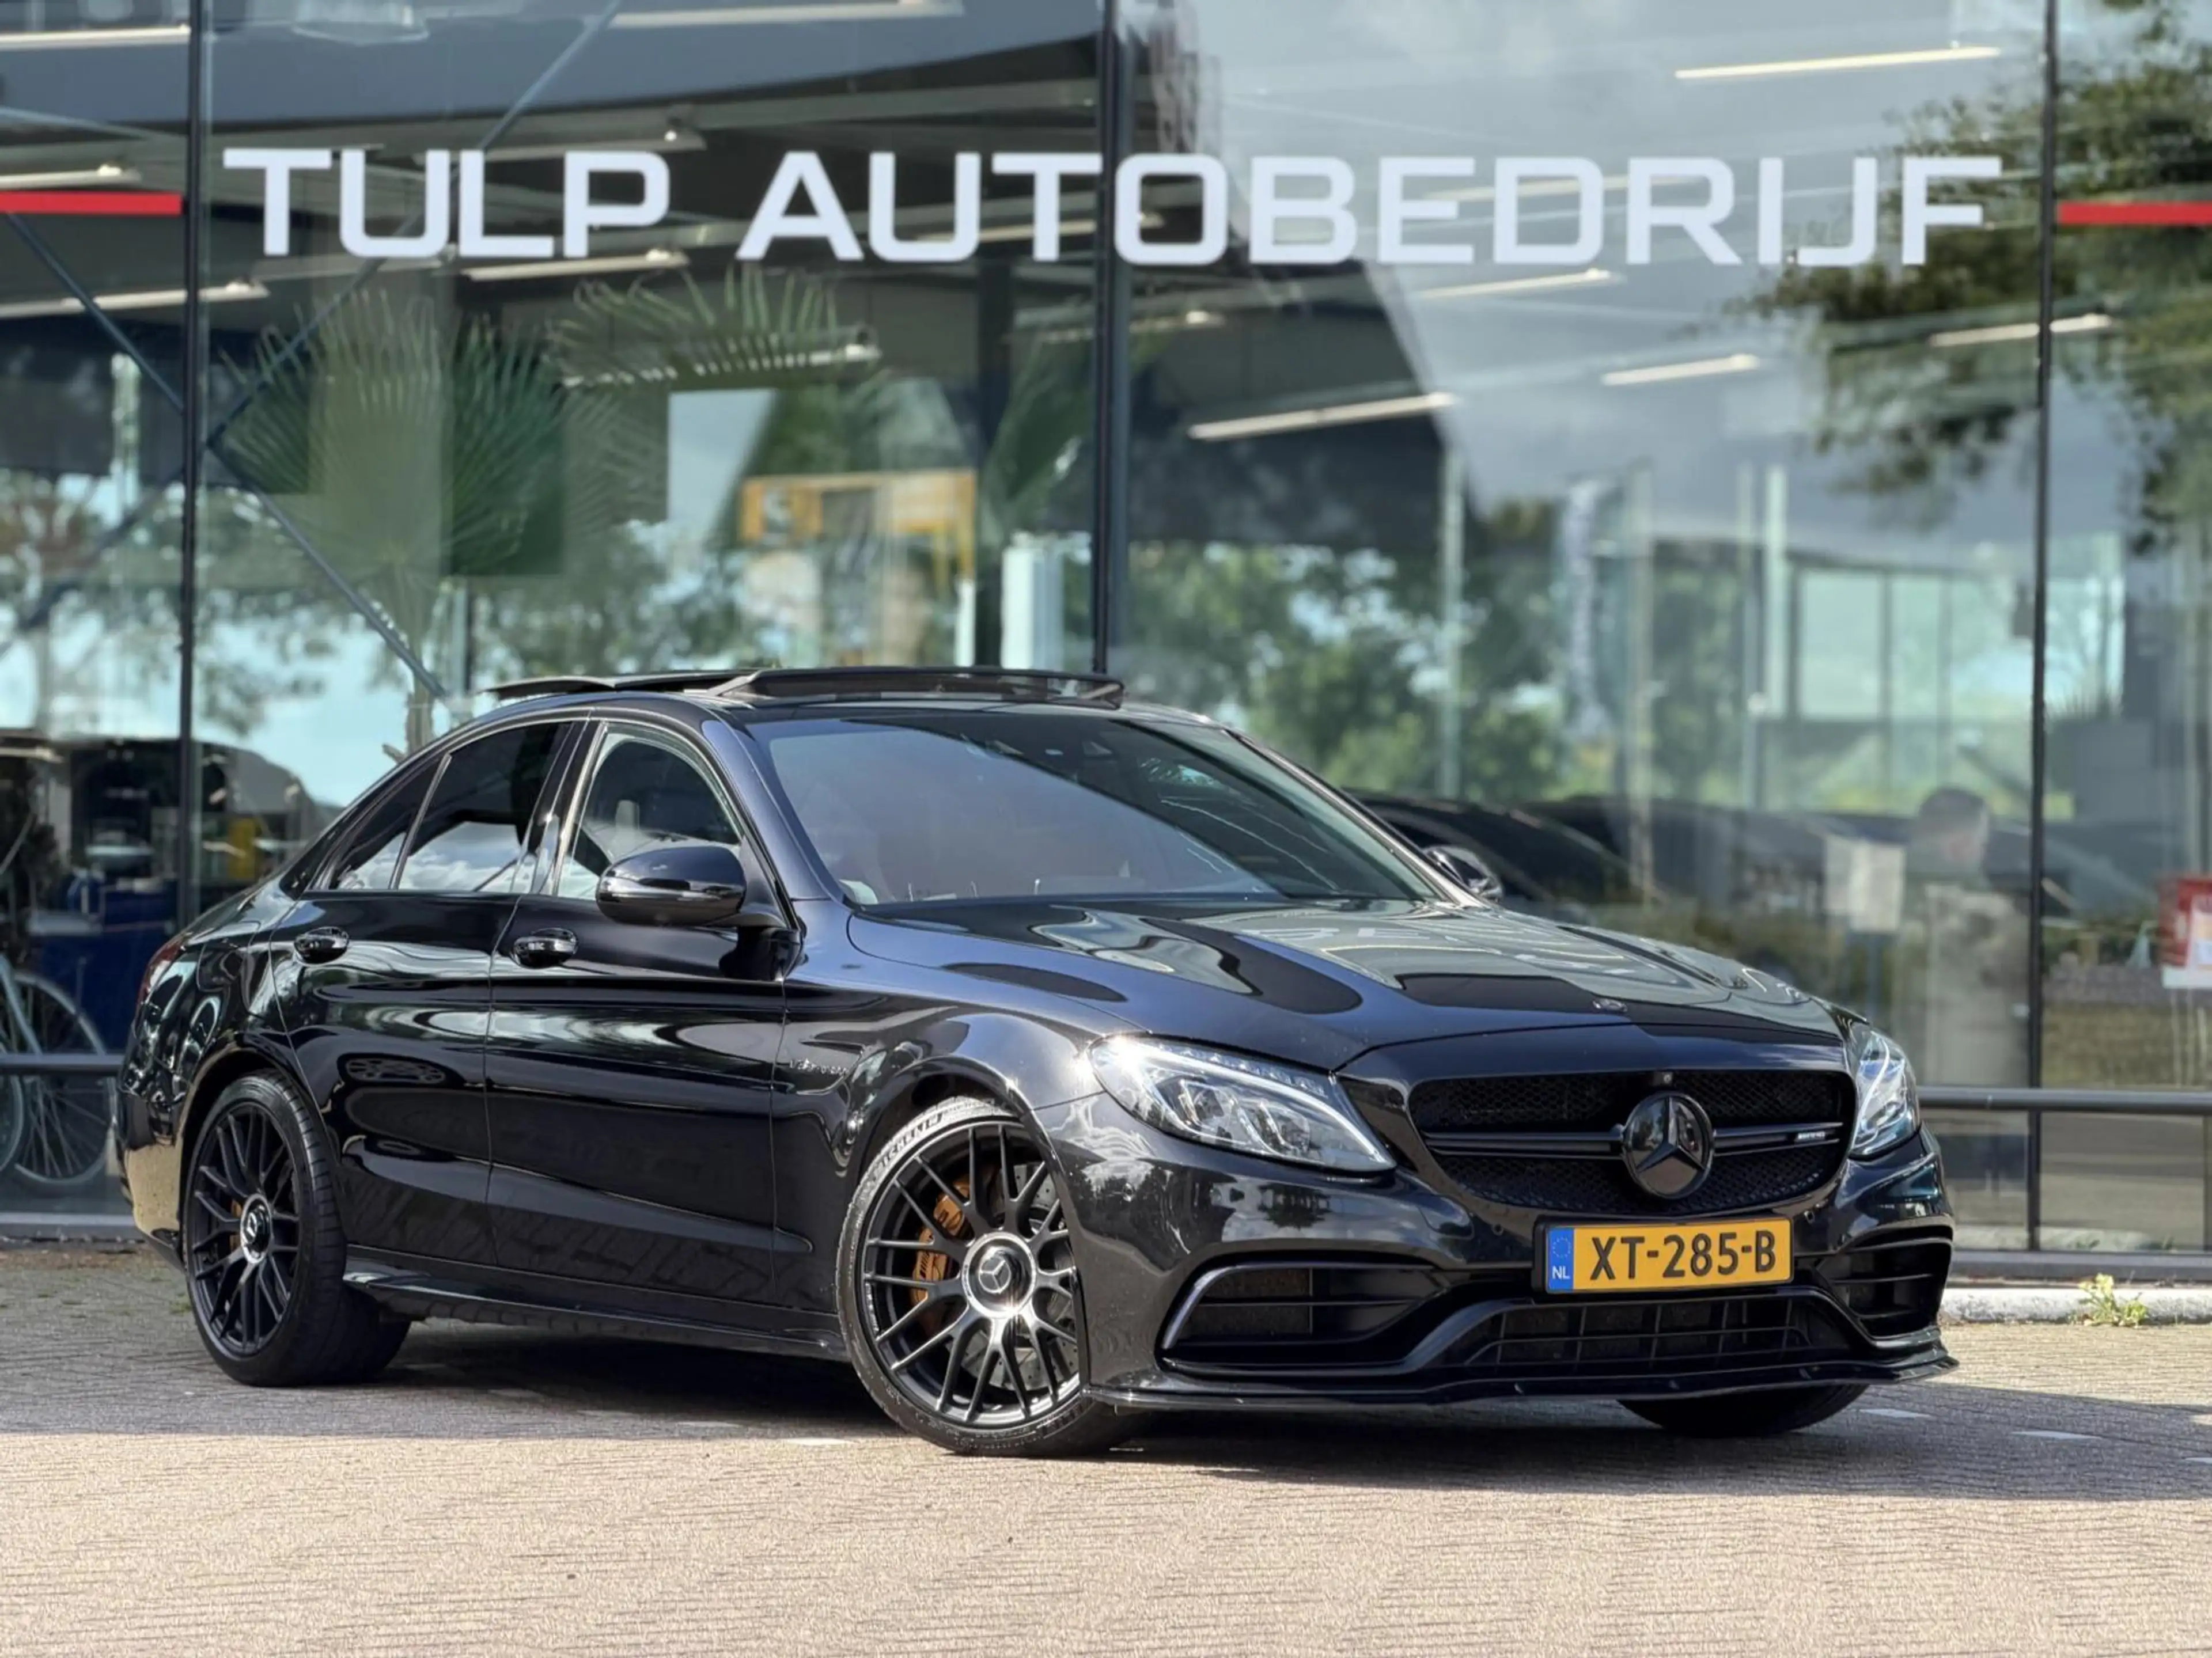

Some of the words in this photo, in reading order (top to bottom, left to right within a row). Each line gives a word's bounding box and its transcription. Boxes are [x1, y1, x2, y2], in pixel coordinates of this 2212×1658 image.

[222, 148, 671, 259] TULP
[737, 151, 2002, 267] AUTOBEDRIJF
[1552, 1266, 1571, 1280] NL
[1590, 1230, 1777, 1280] XT-285-B
